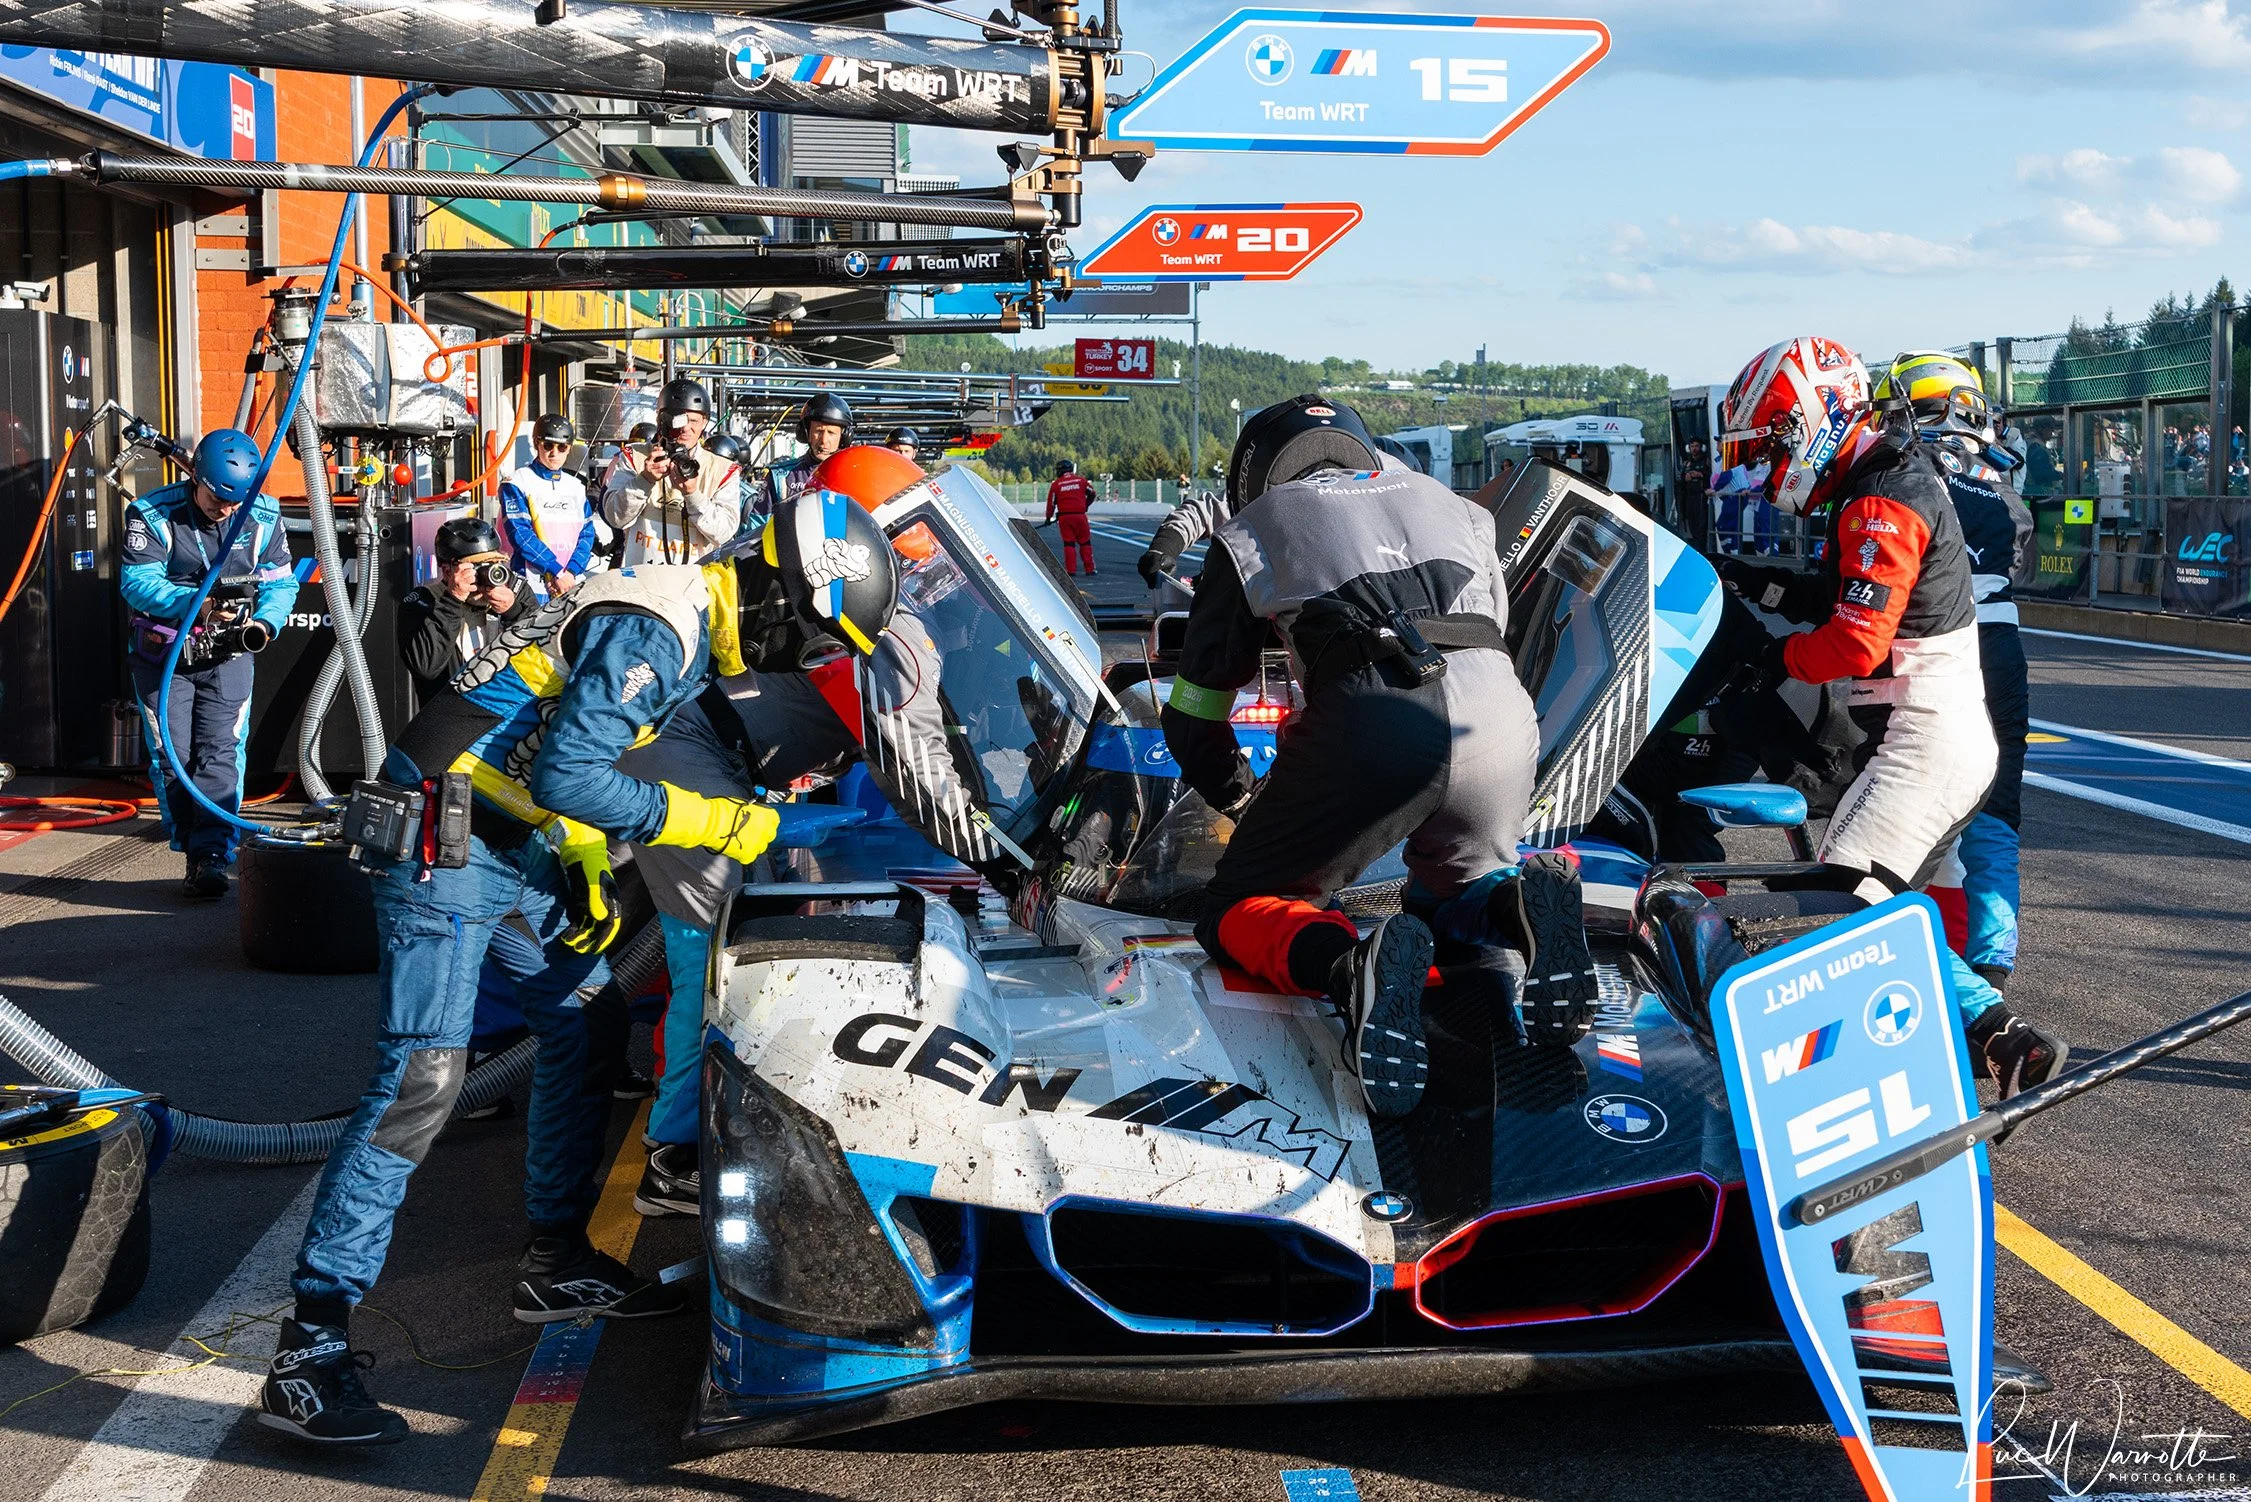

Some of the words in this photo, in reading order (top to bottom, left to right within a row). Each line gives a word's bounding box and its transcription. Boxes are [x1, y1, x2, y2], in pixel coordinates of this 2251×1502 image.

[95, 75, 108, 92] RAST
[871, 61, 947, 96] Team
[955, 69, 1022, 102] WRT
[1410, 57, 1508, 102] 15
[1260, 100, 1315, 121] Team
[1320, 103, 1370, 122] WRT
[232, 104, 254, 139] 20
[1237, 227, 1309, 252] 20
[917, 254, 960, 270] Team
[962, 253, 1000, 269] WRT
[1160, 253, 1193, 265] Team
[1194, 253, 1223, 265] WRT
[1085, 352, 1113, 360] TURKEY
[1117, 344, 1149, 373] 34
[1013, 406, 1034, 426] 12
[1310, 408, 1332, 416] BELL
[1814, 412, 1850, 471] Magnus
[1317, 481, 1410, 496] Motorsport
[1787, 474, 1801, 491] BELL
[1948, 475, 2001, 500] Motorsport
[543, 501, 570, 511] WEC
[1526, 475, 1568, 527] VANTHOOR
[128, 520, 146, 531] OMP
[148, 512, 167, 524] OMP
[257, 512, 276, 524] OMP
[1866, 521, 1899, 534] HELIX
[636, 530, 652, 549] PIT
[2178, 532, 2233, 563] WEC
[937, 493, 989, 555] MAGNUSSEN
[993, 566, 1042, 625] MARCIELLO
[2040, 555, 2074, 574] ROLEX
[2176, 567, 2185, 575] FIA
[2185, 567, 2200, 576] WORLD
[2176, 576, 2210, 585] CHAMPIONSHIP
[1842, 605, 1861, 617] Admin
[1846, 614, 1872, 628] Request
[1830, 776, 1879, 845] Motorsport
[1827, 939, 1897, 980] Team
[1594, 963, 1635, 1028] Motorsport
[1763, 970, 1825, 1015] WRT
[832, 1012, 1083, 1113] GEN
[1785, 1070, 1932, 1179] 15
